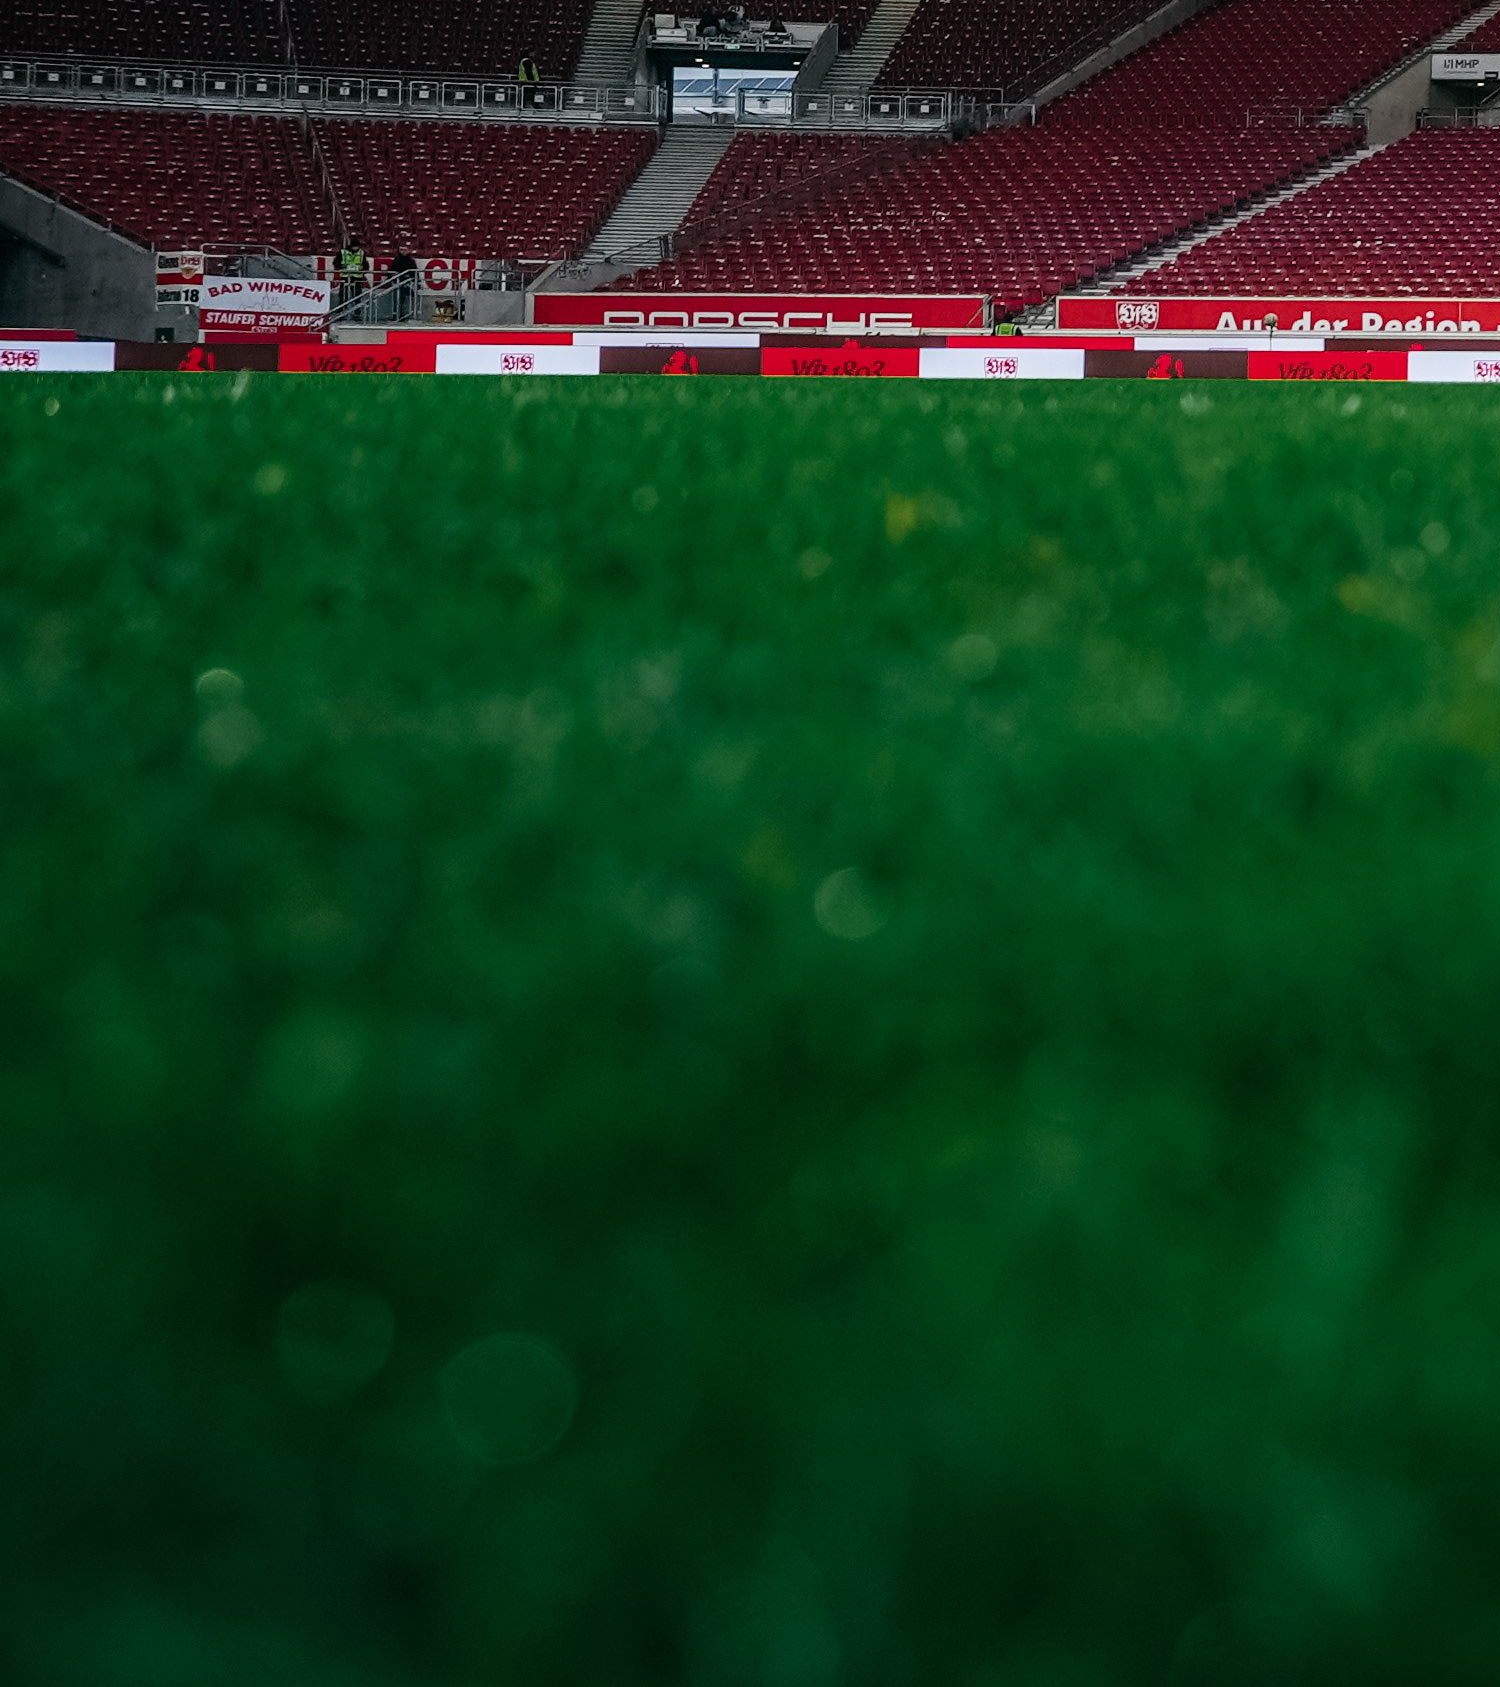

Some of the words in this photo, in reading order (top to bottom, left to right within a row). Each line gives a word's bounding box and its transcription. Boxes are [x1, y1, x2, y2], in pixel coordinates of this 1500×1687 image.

[207, 283, 243, 298] BAD
[247, 281, 325, 303] WIMPFEN
[205, 312, 256, 326] STAUFER
[1215, 311, 1276, 331] Au
[1291, 310, 1349, 331] der
